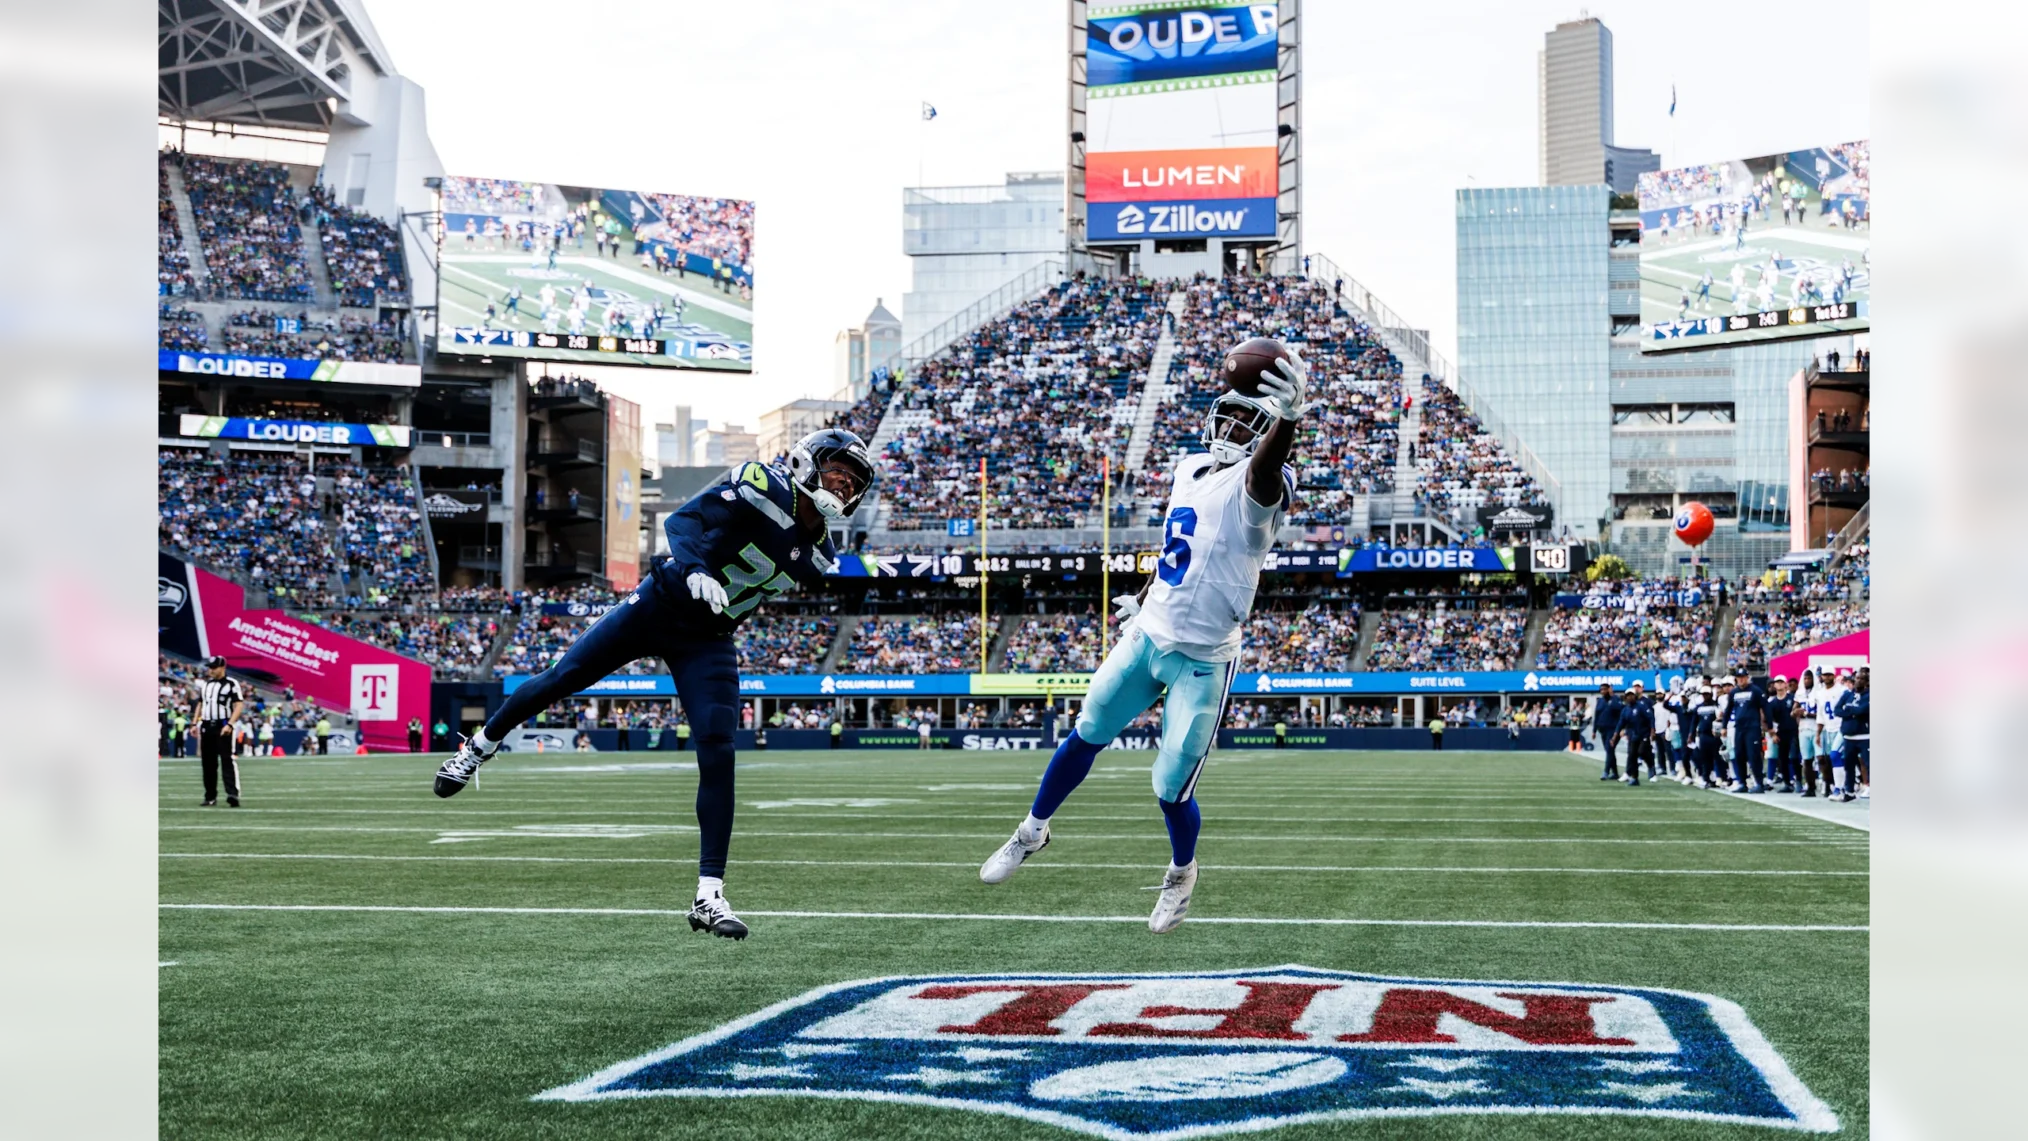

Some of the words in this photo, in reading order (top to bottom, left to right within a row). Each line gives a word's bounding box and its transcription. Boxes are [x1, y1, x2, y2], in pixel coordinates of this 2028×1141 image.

[1122, 164, 1241, 188] LUMEN
[1148, 204, 1244, 233] Zillow
[281, 319, 298, 334] 12
[1705, 317, 1722, 335] 10
[1839, 304, 1848, 318] 2
[512, 330, 530, 347] 10
[649, 340, 658, 354] 2
[675, 342, 684, 356] 7
[178, 354, 287, 379] LOUDER
[248, 423, 350, 444] LOUDER
[952, 519, 970, 535] 12
[1158, 507, 1197, 587] 6
[942, 555, 962, 575] 10
[1041, 557, 1051, 571] 2
[1075, 557, 1085, 571] 3
[1376, 550, 1475, 569] LOUDER
[1536, 548, 1565, 569] 40
[1677, 593, 1694, 607] 12
[264, 617, 302, 637] T-Mobile
[228, 617, 304, 652] America's
[303, 641, 340, 665] Best
[240, 634, 275, 655] Mobile
[275, 646, 321, 670] Network
[628, 680, 656, 690] BANK
[836, 680, 886, 690] COLUMBIA
[887, 680, 915, 690] BANK
[1271, 678, 1323, 688] COLUMBIA
[1325, 678, 1353, 688] BANK
[1410, 677, 1436, 687] SUITE
[1438, 677, 1466, 687] LEVEL
[1539, 676, 1593, 686] COLUMBIA
[1594, 675, 1624, 686] BANK
[361, 675, 388, 710] T
[1823, 700, 1835, 720] 4
[962, 734, 1058, 750] SEATT
[908, 980, 1638, 1047] NFL
